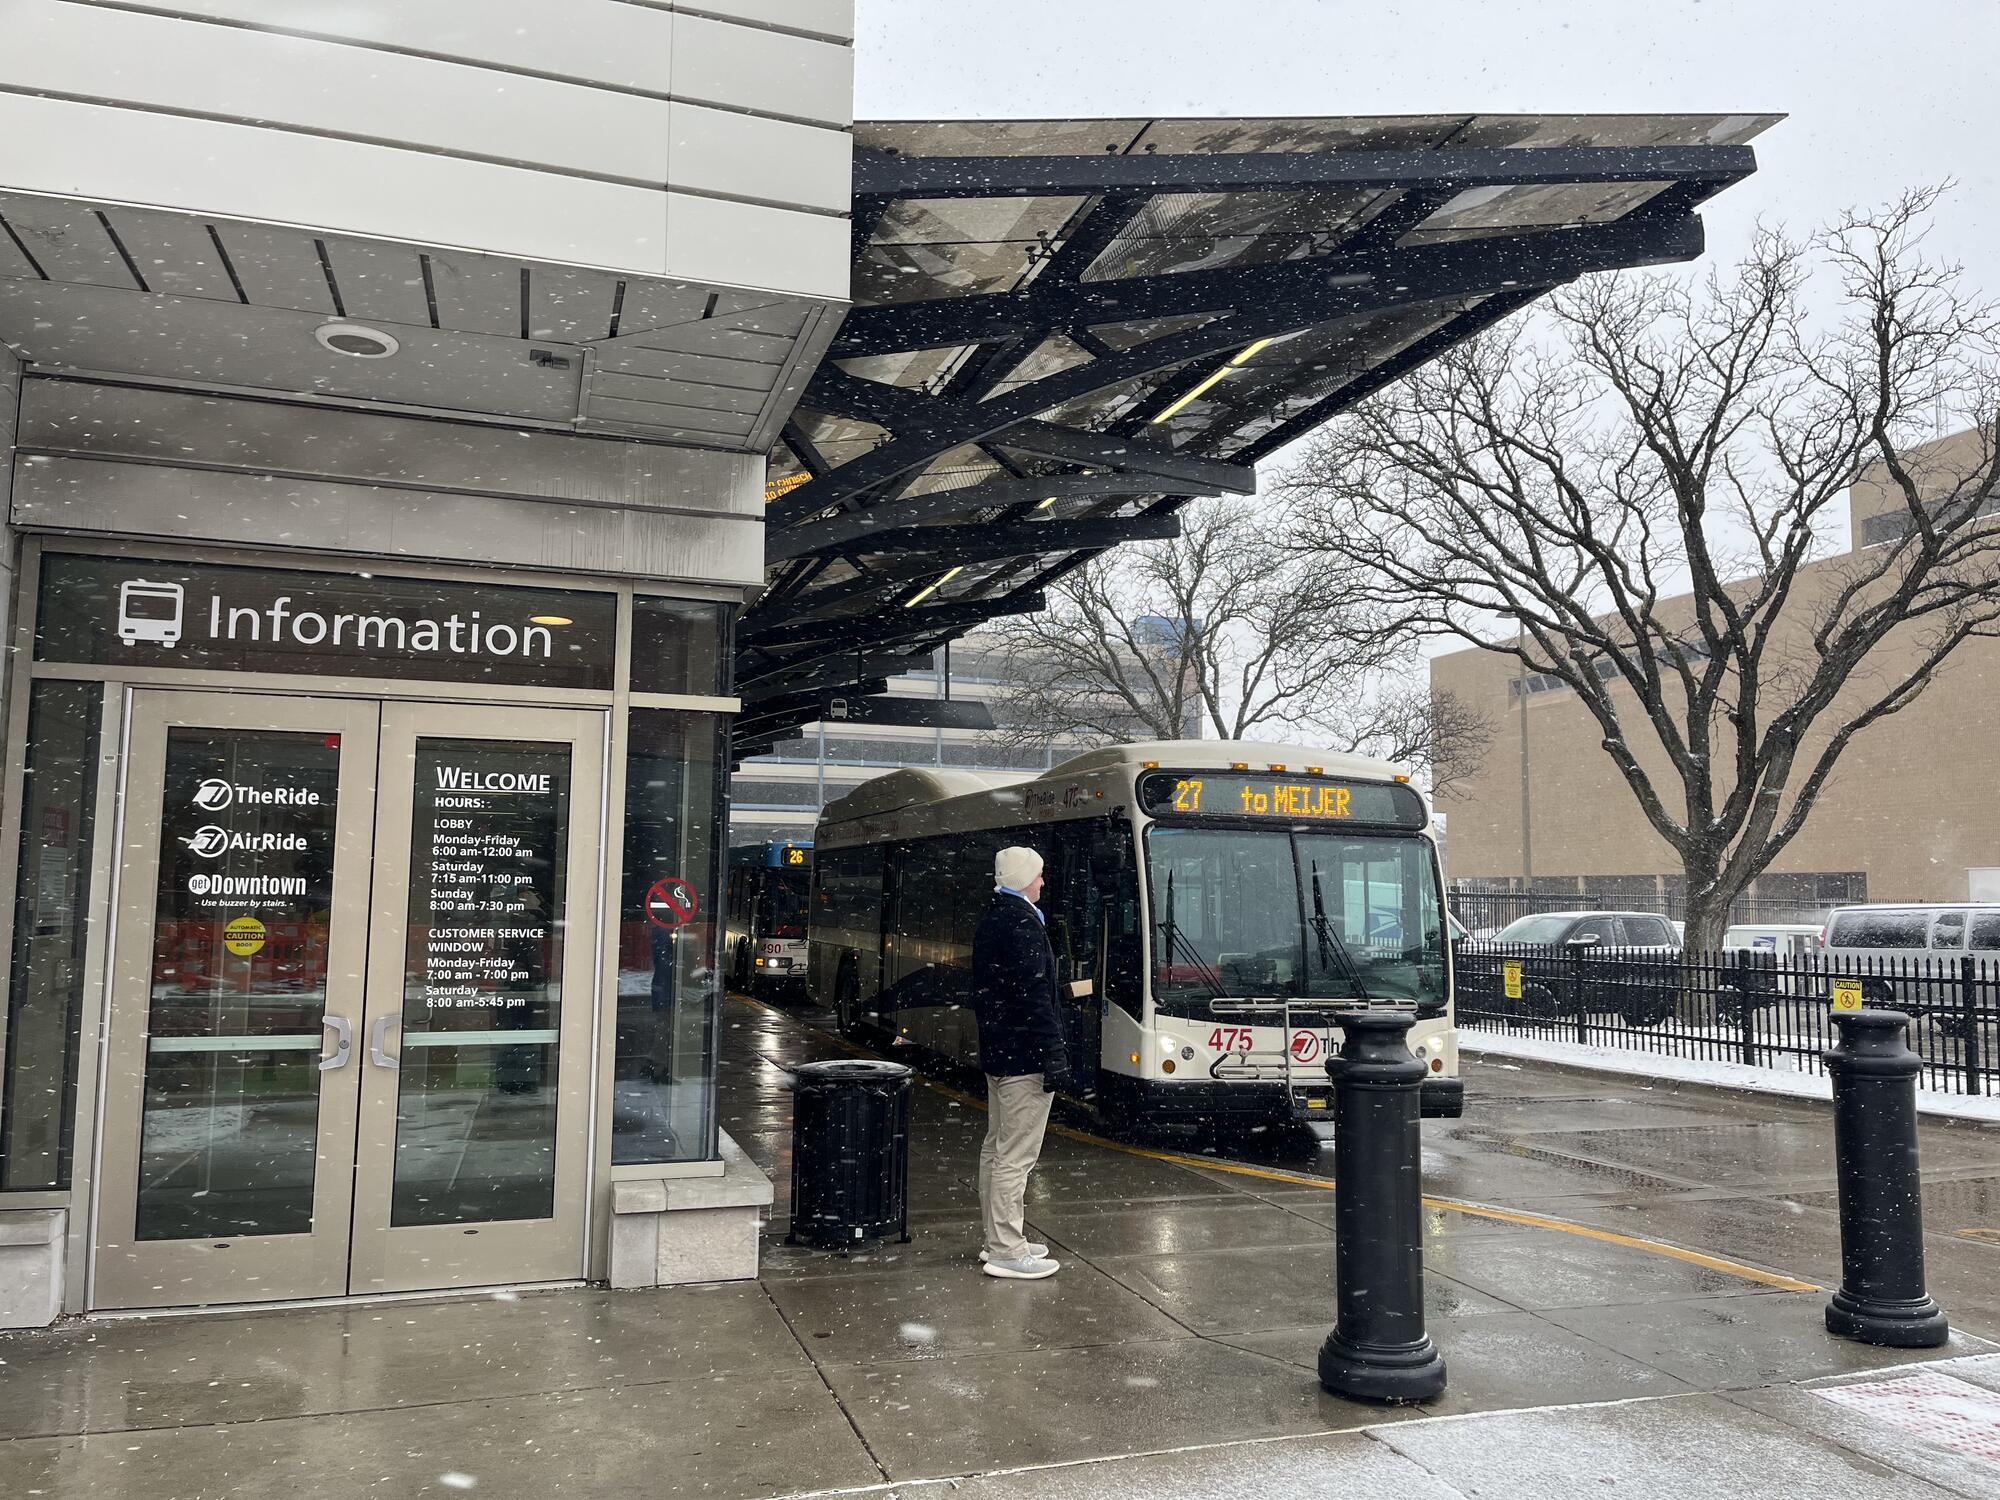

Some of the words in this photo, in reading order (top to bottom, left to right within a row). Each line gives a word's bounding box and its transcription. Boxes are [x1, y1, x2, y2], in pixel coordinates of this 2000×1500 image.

[210, 595, 552, 658] Information
[234, 786, 320, 806] TheRide
[1175, 780, 1203, 812] 27
[1241, 786, 1268, 812] to
[1273, 785, 1351, 816] MEIJER
[434, 797, 485, 809] HOURS:
[433, 818, 473, 829] LOBBY
[229, 833, 308, 851] AirRide
[433, 834, 520, 848] Monday-Friday
[432, 845, 457, 856] 6:00
[459, 847, 513, 857] am-12:00
[515, 849, 533, 857] am
[789, 850, 804, 864] 26
[431, 861, 484, 874] Saturday
[191, 876, 209, 890] get
[211, 874, 306, 896] Downtown
[431, 873, 457, 884] 7:15
[458, 874, 512, 885] am-11:00
[514, 877, 533, 886] pm
[430, 888, 474, 901] Sunday
[201, 899, 216, 907] Use
[219, 899, 248, 908] buzzer
[250, 900, 260, 908] by
[262, 899, 287, 908] stairs.
[429, 901, 455, 911] 8:00
[457, 902, 503, 912] am-7:30
[506, 905, 525, 913] pm
[428, 928, 494, 939] CUSTOMER
[497, 929, 544, 939] SERVICE
[428, 942, 484, 952] WINDOW
[427, 957, 515, 970] Monday-Friday
[427, 969, 452, 980] 7:00
[454, 971, 473, 979] am
[483, 970, 508, 979] 7:00
[510, 972, 529, 981] pm
[425, 985, 479, 997] Saturday
[1835, 981, 1861, 990] CAUTION
[426, 997, 452, 1007] 8:00
[455, 997, 504, 1007] am-5:45
[506, 998, 526, 1008] pm
[1208, 1028, 1253, 1051] 475
[1320, 1037, 1345, 1054] Th
